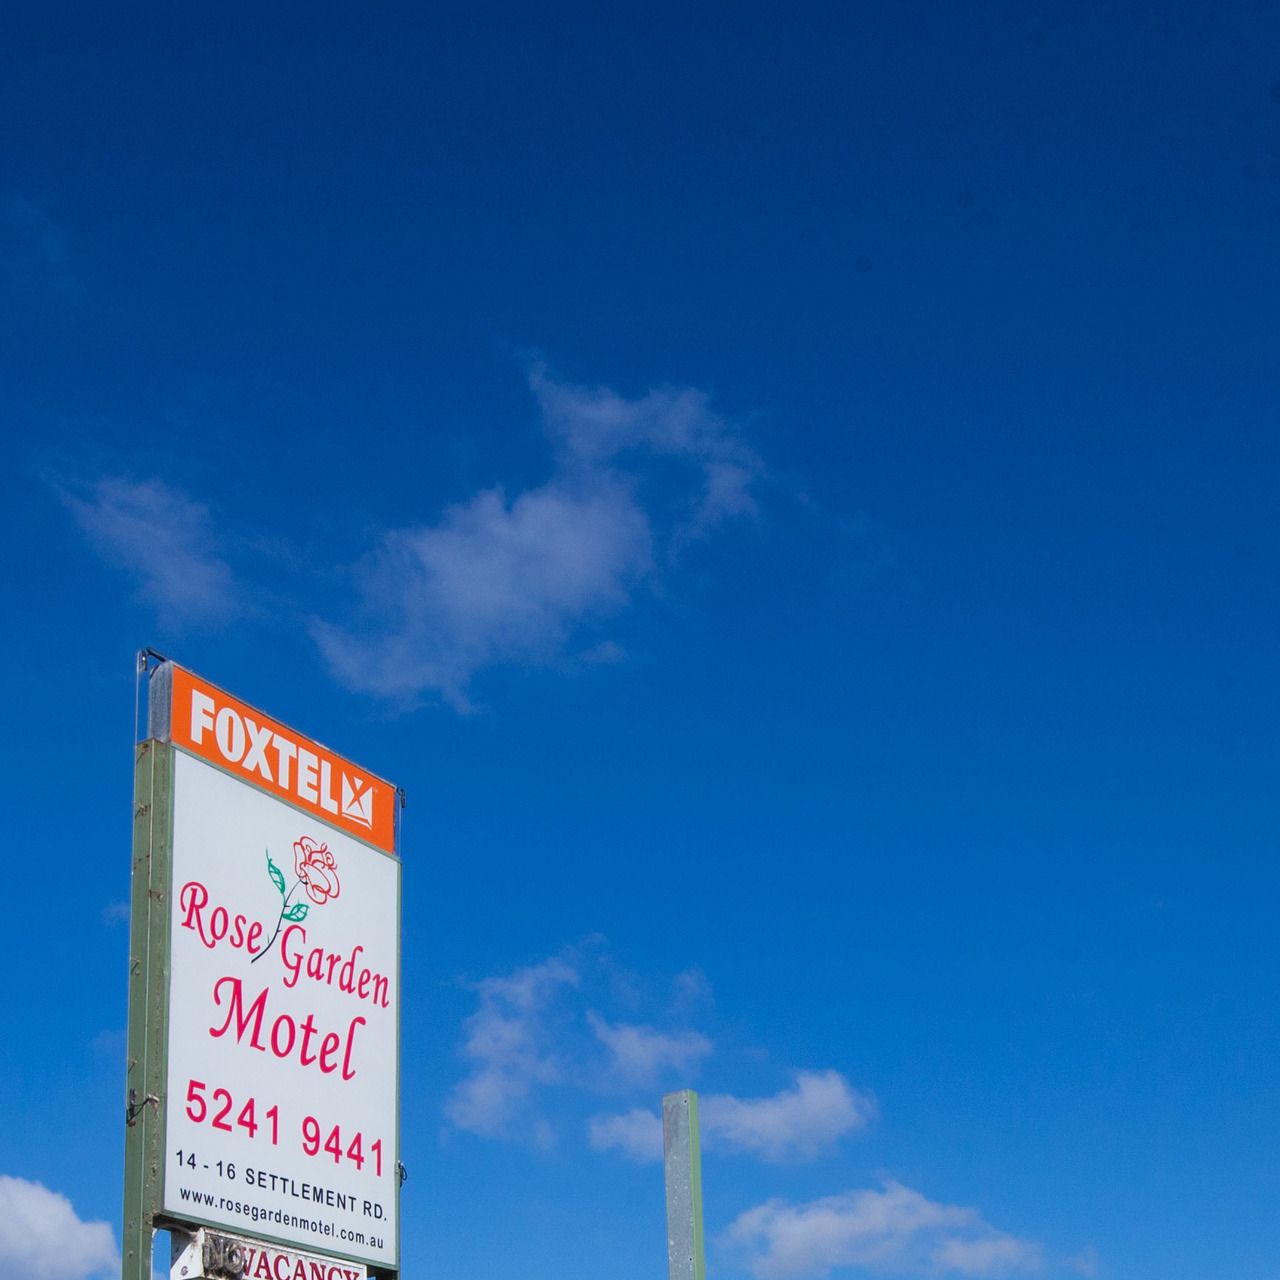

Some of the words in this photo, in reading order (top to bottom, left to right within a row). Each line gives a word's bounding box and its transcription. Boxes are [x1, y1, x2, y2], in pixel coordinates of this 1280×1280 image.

[190, 689, 338, 816] FOXTEL
[180, 881, 263, 954] Rose
[281, 924, 390, 1008] Garden
[209, 976, 366, 1081] Motel
[185, 1079, 278, 1145] 5241
[302, 1116, 382, 1177] 9441
[176, 1150, 197, 1170] 14
[216, 1160, 236, 1180] 16
[246, 1168, 357, 1212] SETTLEMENT
[363, 1200, 387, 1221] RD.
[180, 1187, 384, 1249] www.rosegardenmotel.com.au
